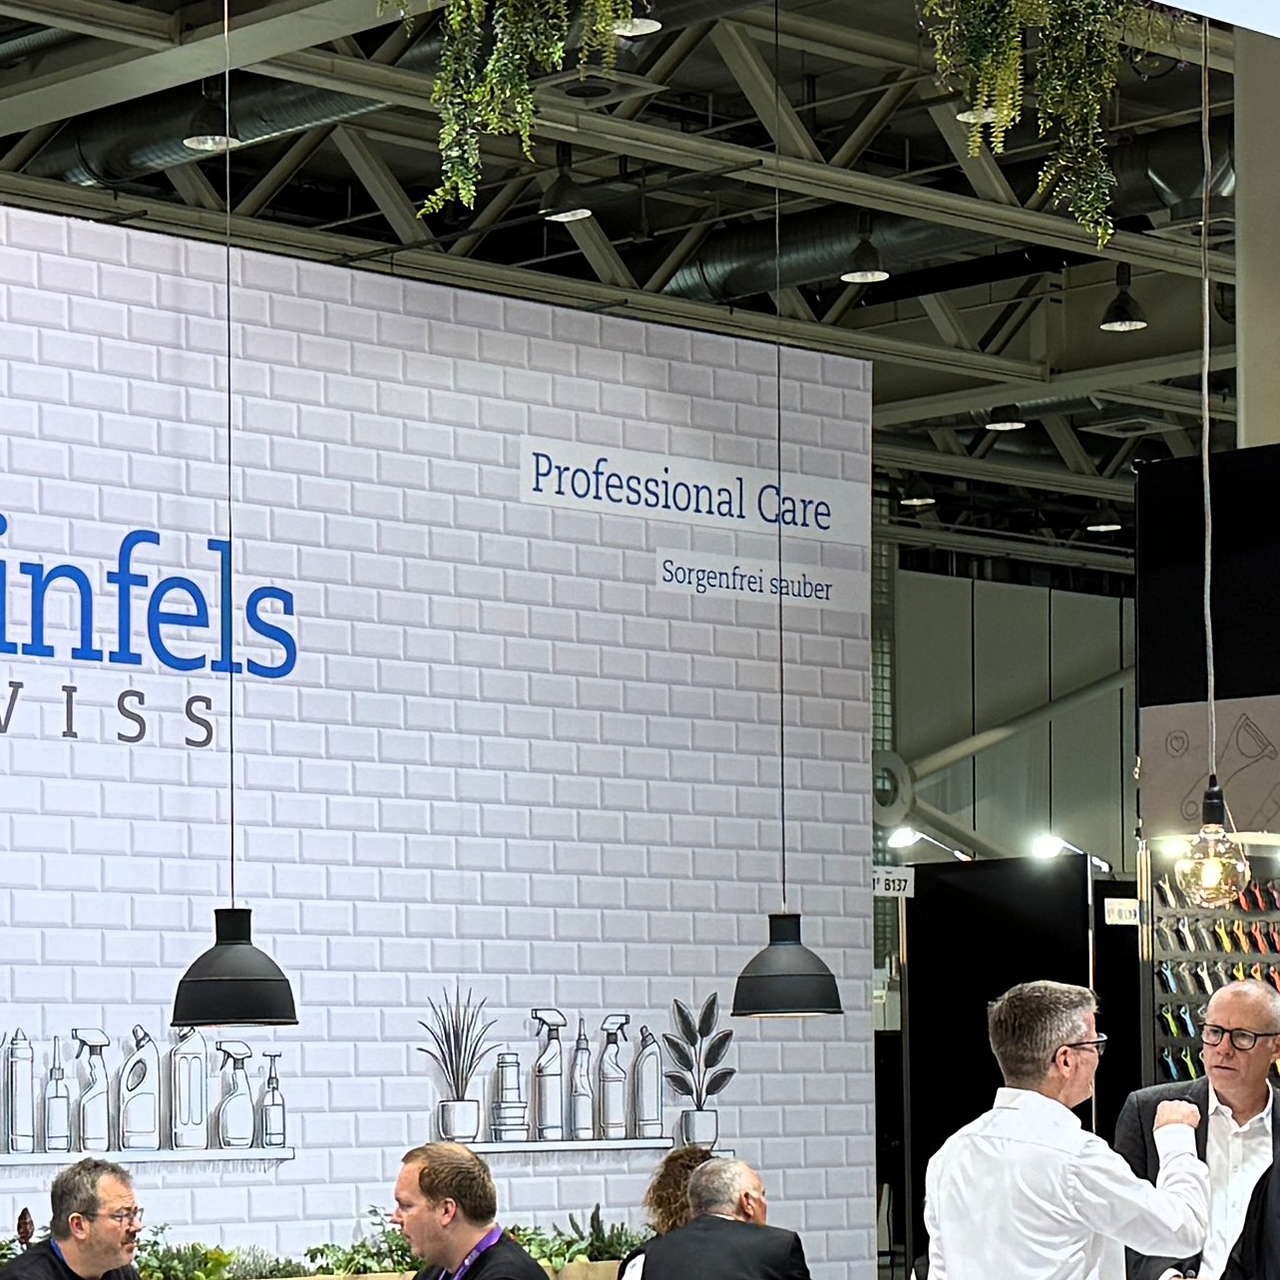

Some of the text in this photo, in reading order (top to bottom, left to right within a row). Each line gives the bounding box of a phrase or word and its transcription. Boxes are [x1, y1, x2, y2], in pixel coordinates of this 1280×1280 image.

[532, 452, 832, 531] Professional Care
[662, 559, 833, 601] Sorgenfrei sauber
[884, 878, 908, 892] B137
